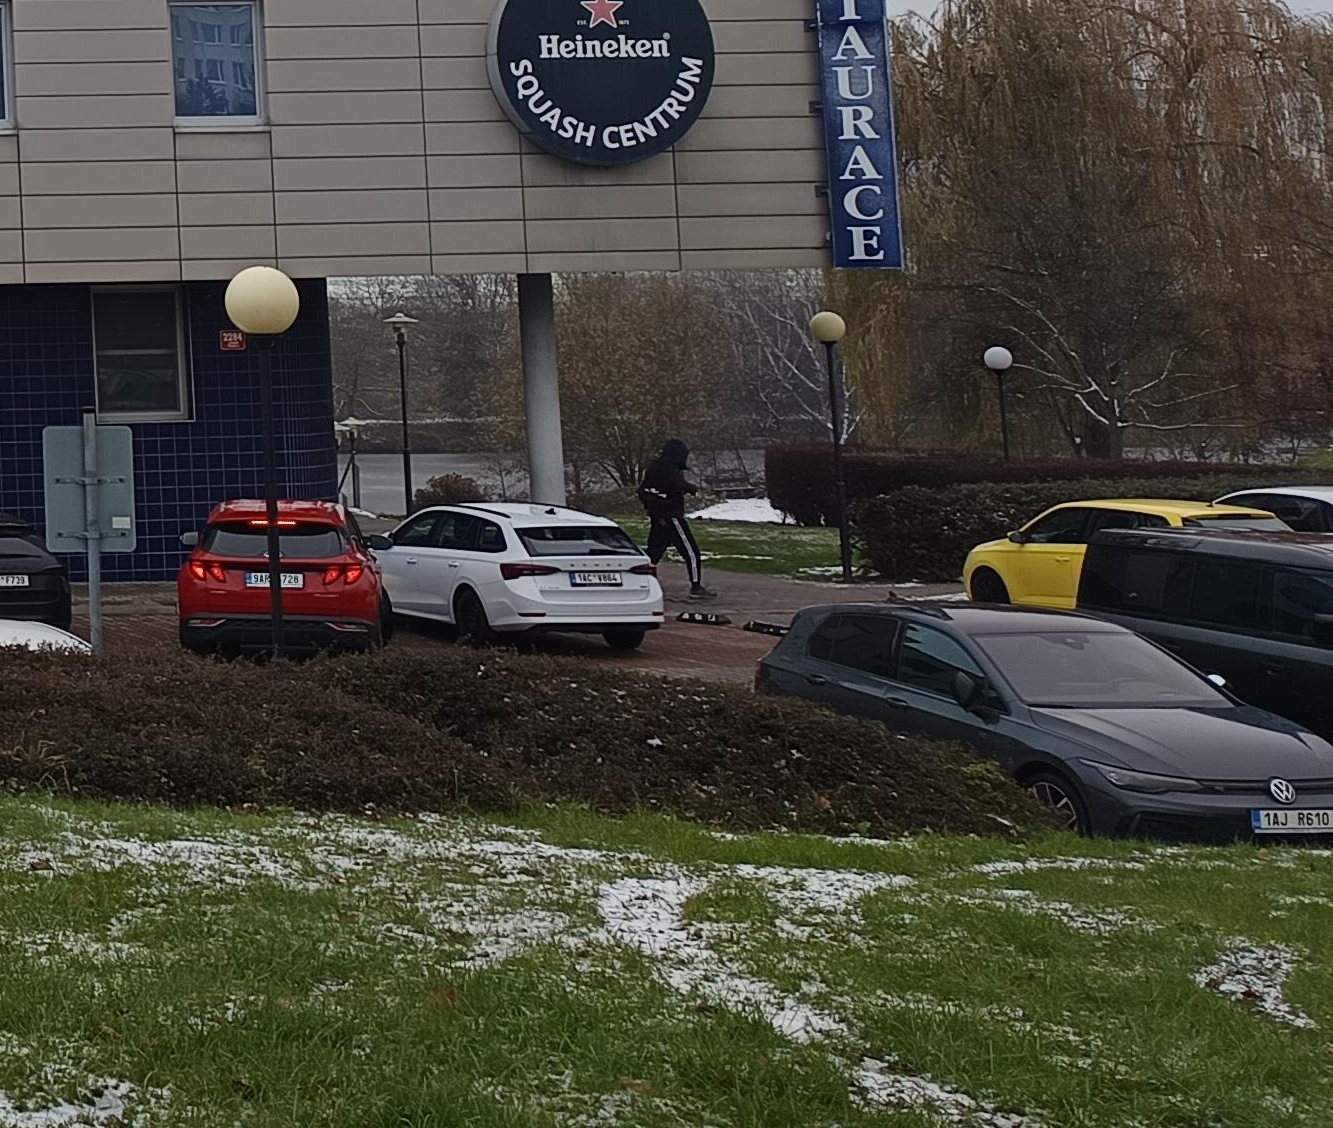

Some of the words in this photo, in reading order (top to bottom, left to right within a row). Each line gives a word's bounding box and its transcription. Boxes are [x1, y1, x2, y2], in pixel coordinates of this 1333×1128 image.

[510, 59, 596, 147] SQUASH
[602, 57, 703, 149] CENTRUM
[1264, 812, 1288, 826] 1AJ
[1297, 812, 1330, 826] R610
